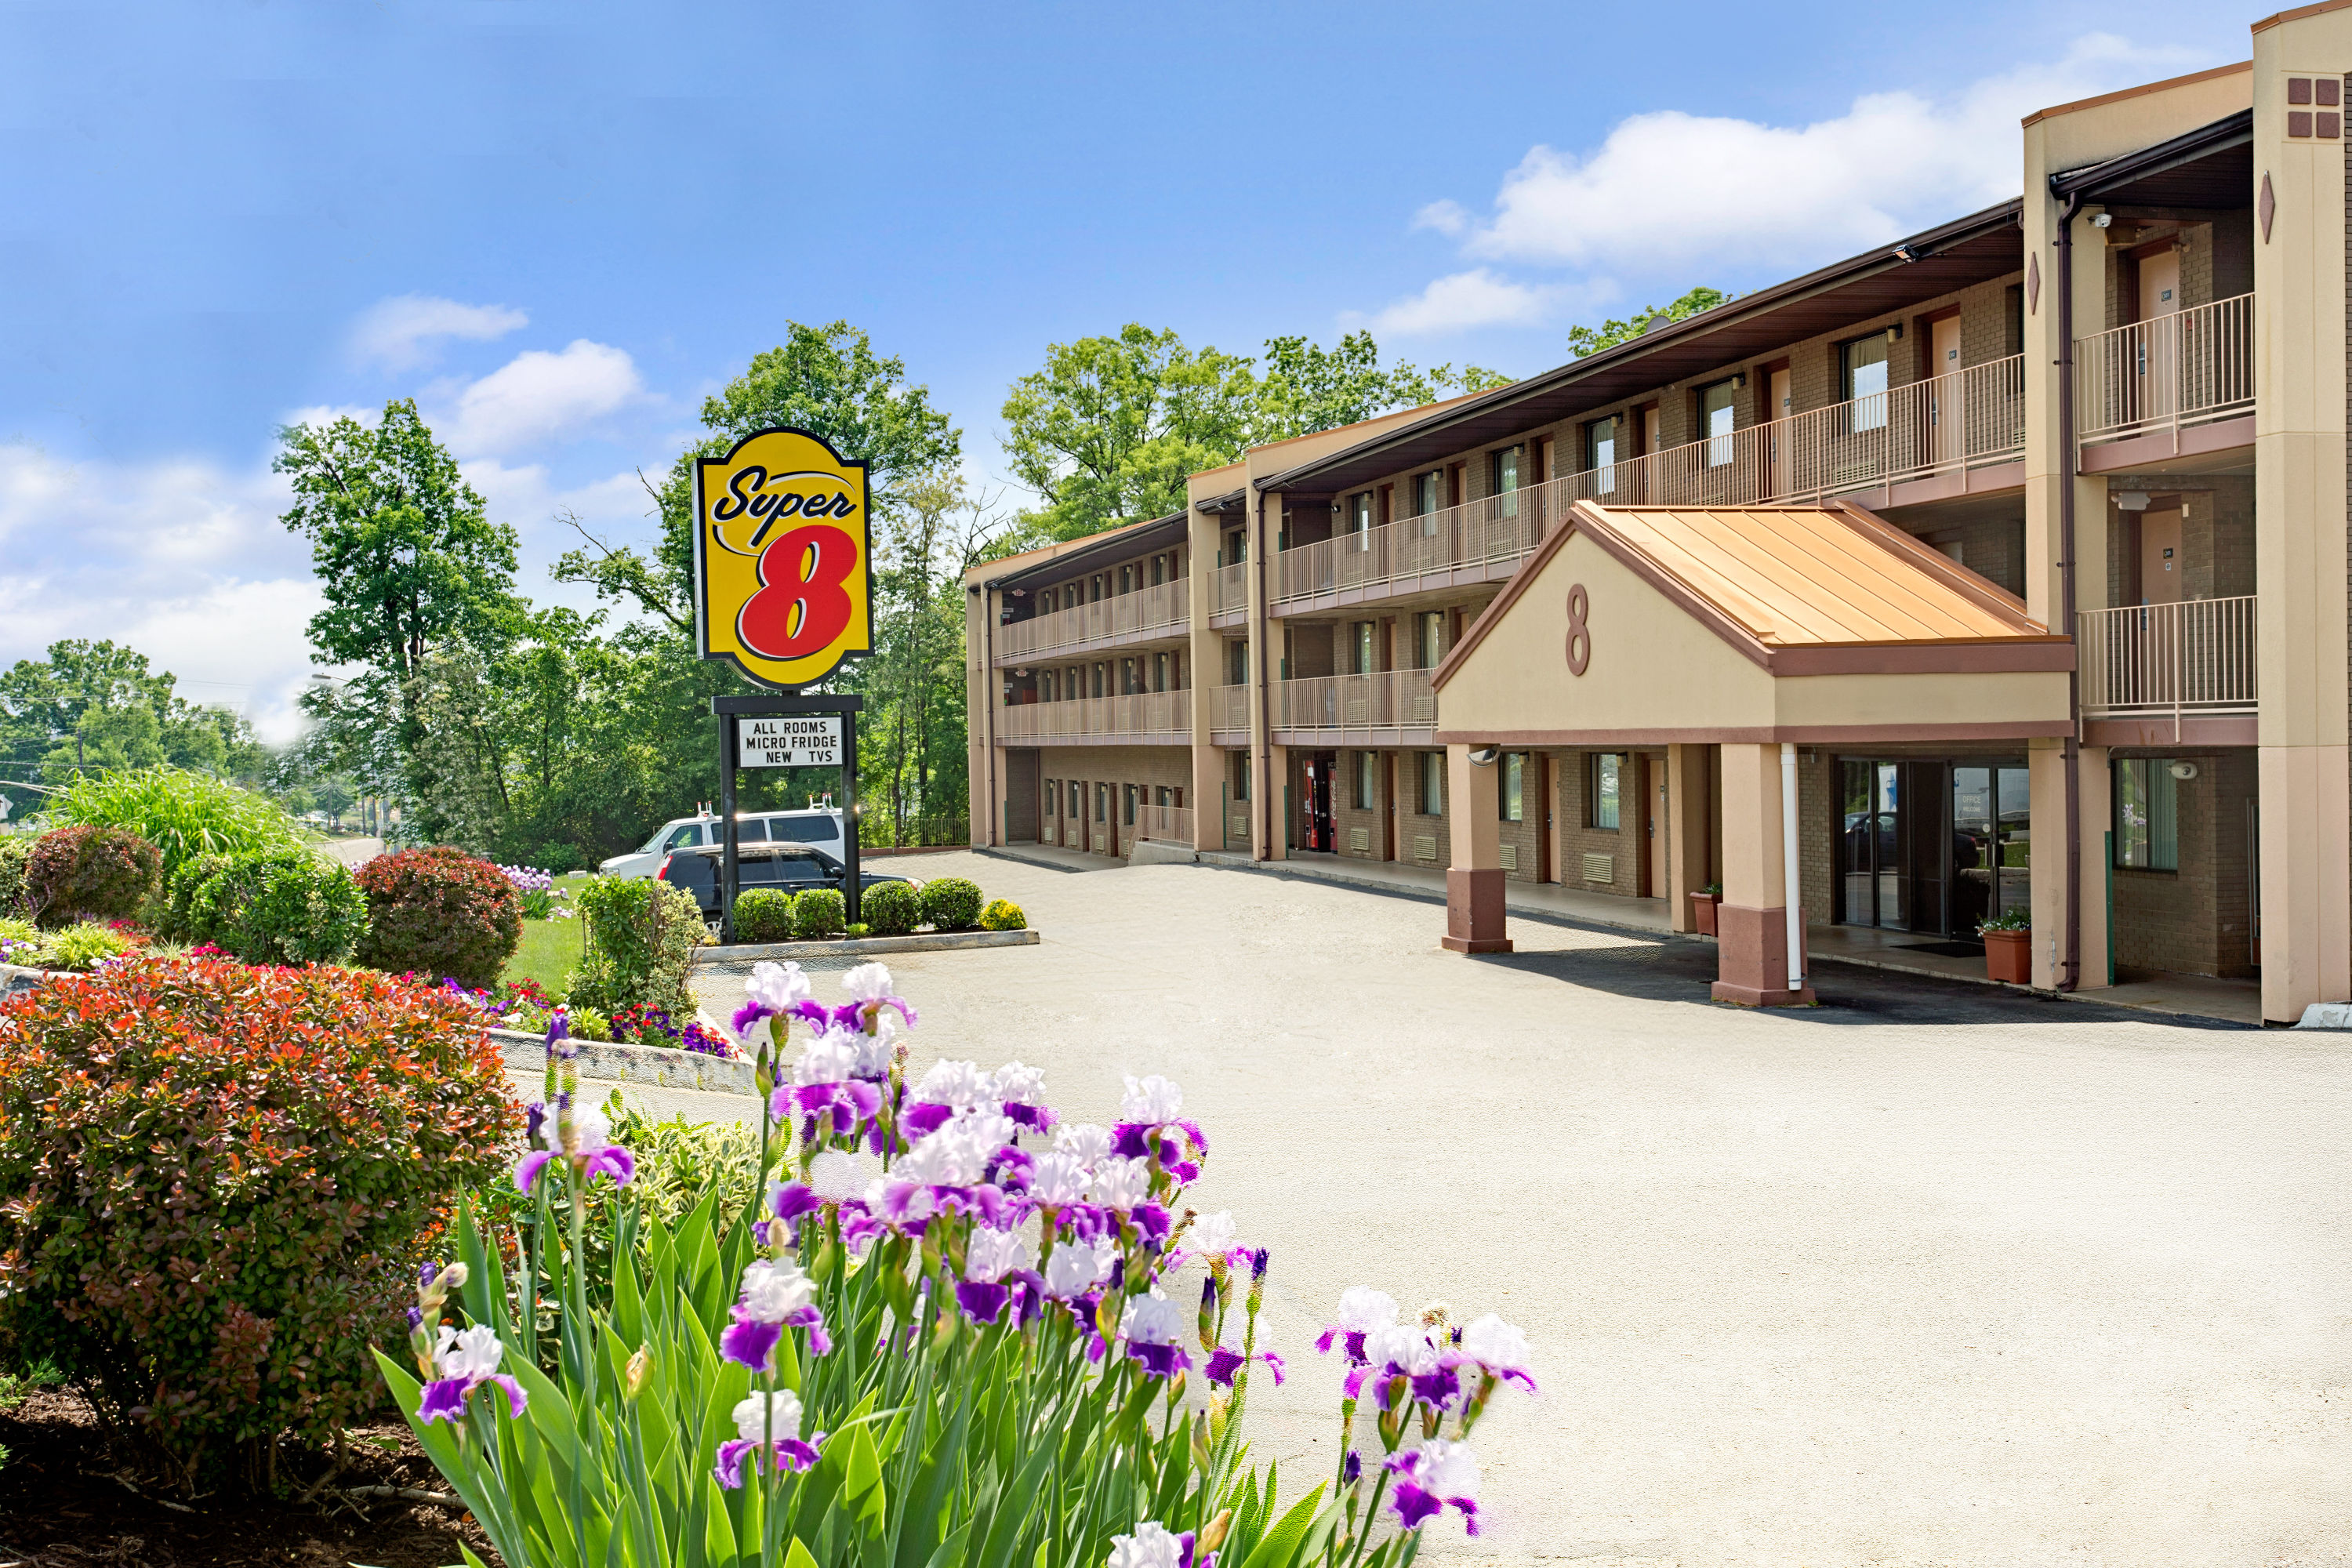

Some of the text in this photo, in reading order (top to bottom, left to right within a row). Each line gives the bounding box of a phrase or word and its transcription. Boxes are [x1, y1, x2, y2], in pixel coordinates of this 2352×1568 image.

[711, 466, 858, 549] Super
[735, 524, 858, 662] 8
[1566, 583, 1590, 677] 8
[753, 721, 826, 735] ALL ROOMS
[746, 735, 837, 749] MICRO FRIDGE
[766, 750, 833, 763] NEW TVS
[1962, 795, 1981, 804] OFFICE
